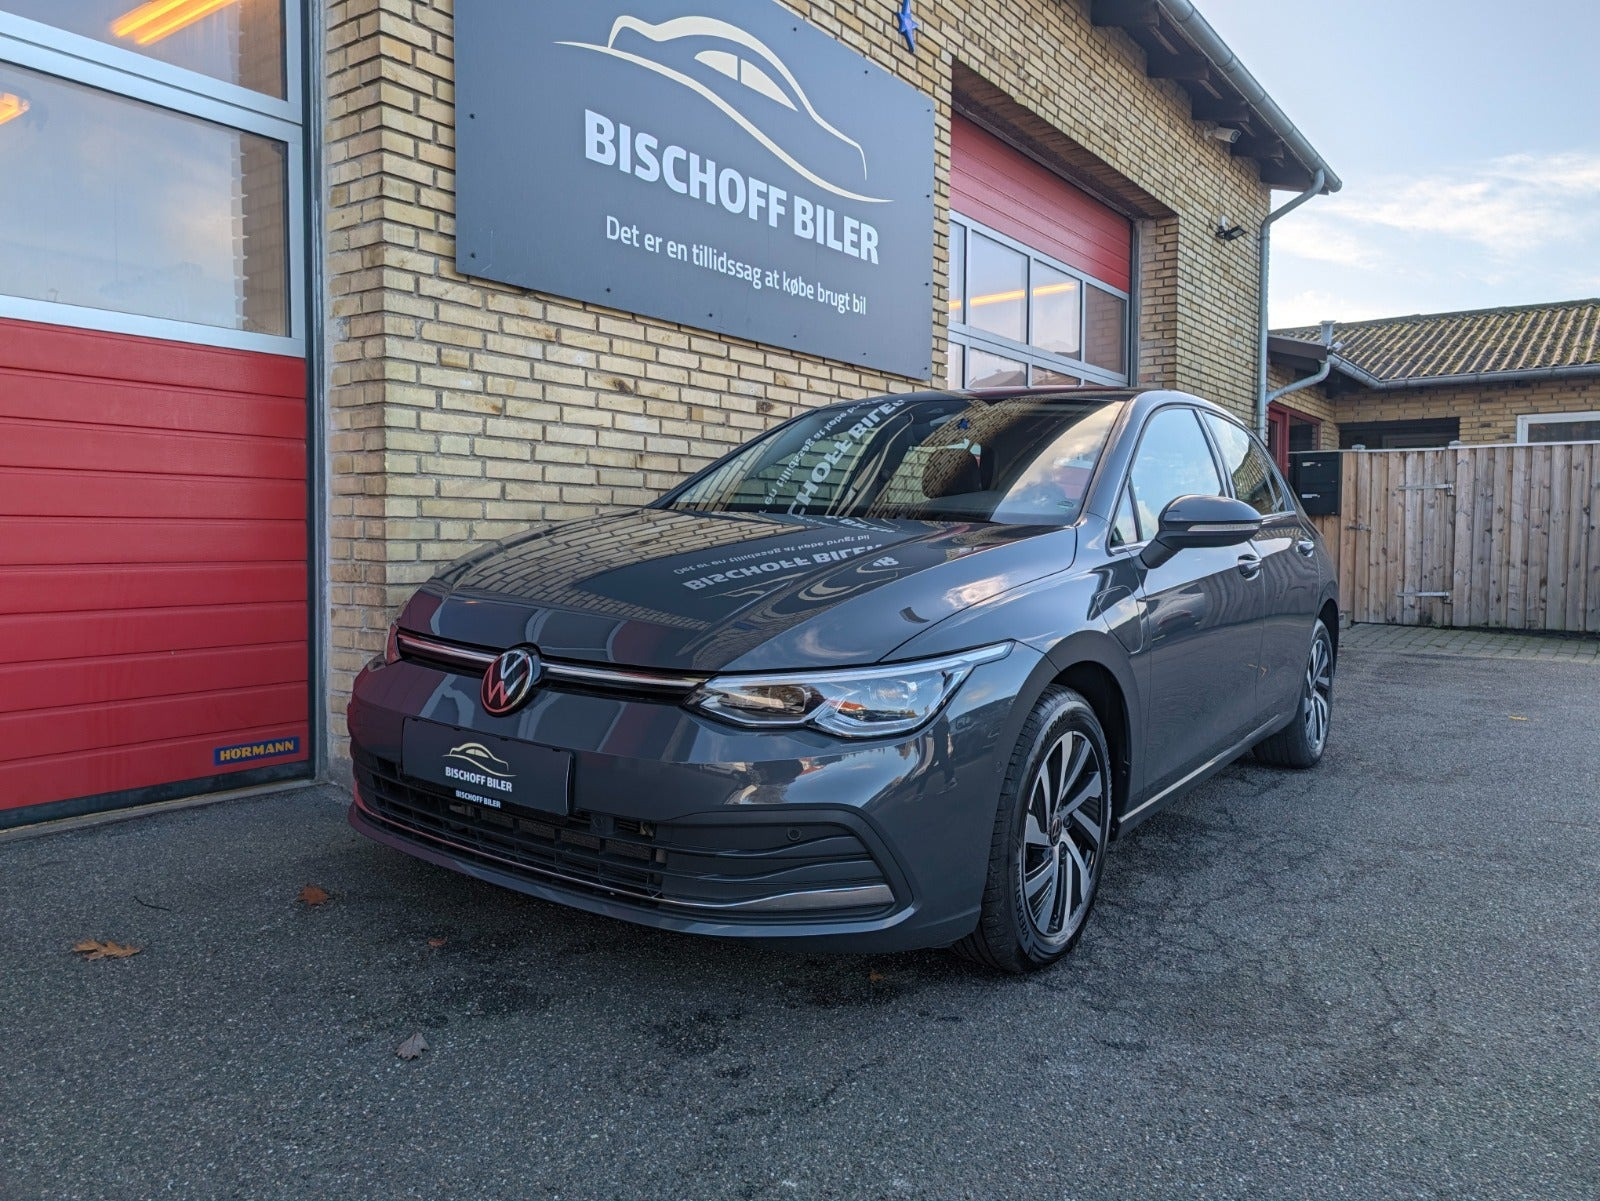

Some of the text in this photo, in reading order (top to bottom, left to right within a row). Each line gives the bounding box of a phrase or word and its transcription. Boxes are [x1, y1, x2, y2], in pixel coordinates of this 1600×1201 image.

[584, 108, 880, 266] BISCHOFF BILER
[606, 215, 867, 316] Det er en tillidssag at købe brugt bil
[444, 766, 513, 792] BISCHOFF BILER
[455, 790, 501, 809] BISCHOFF BILER
